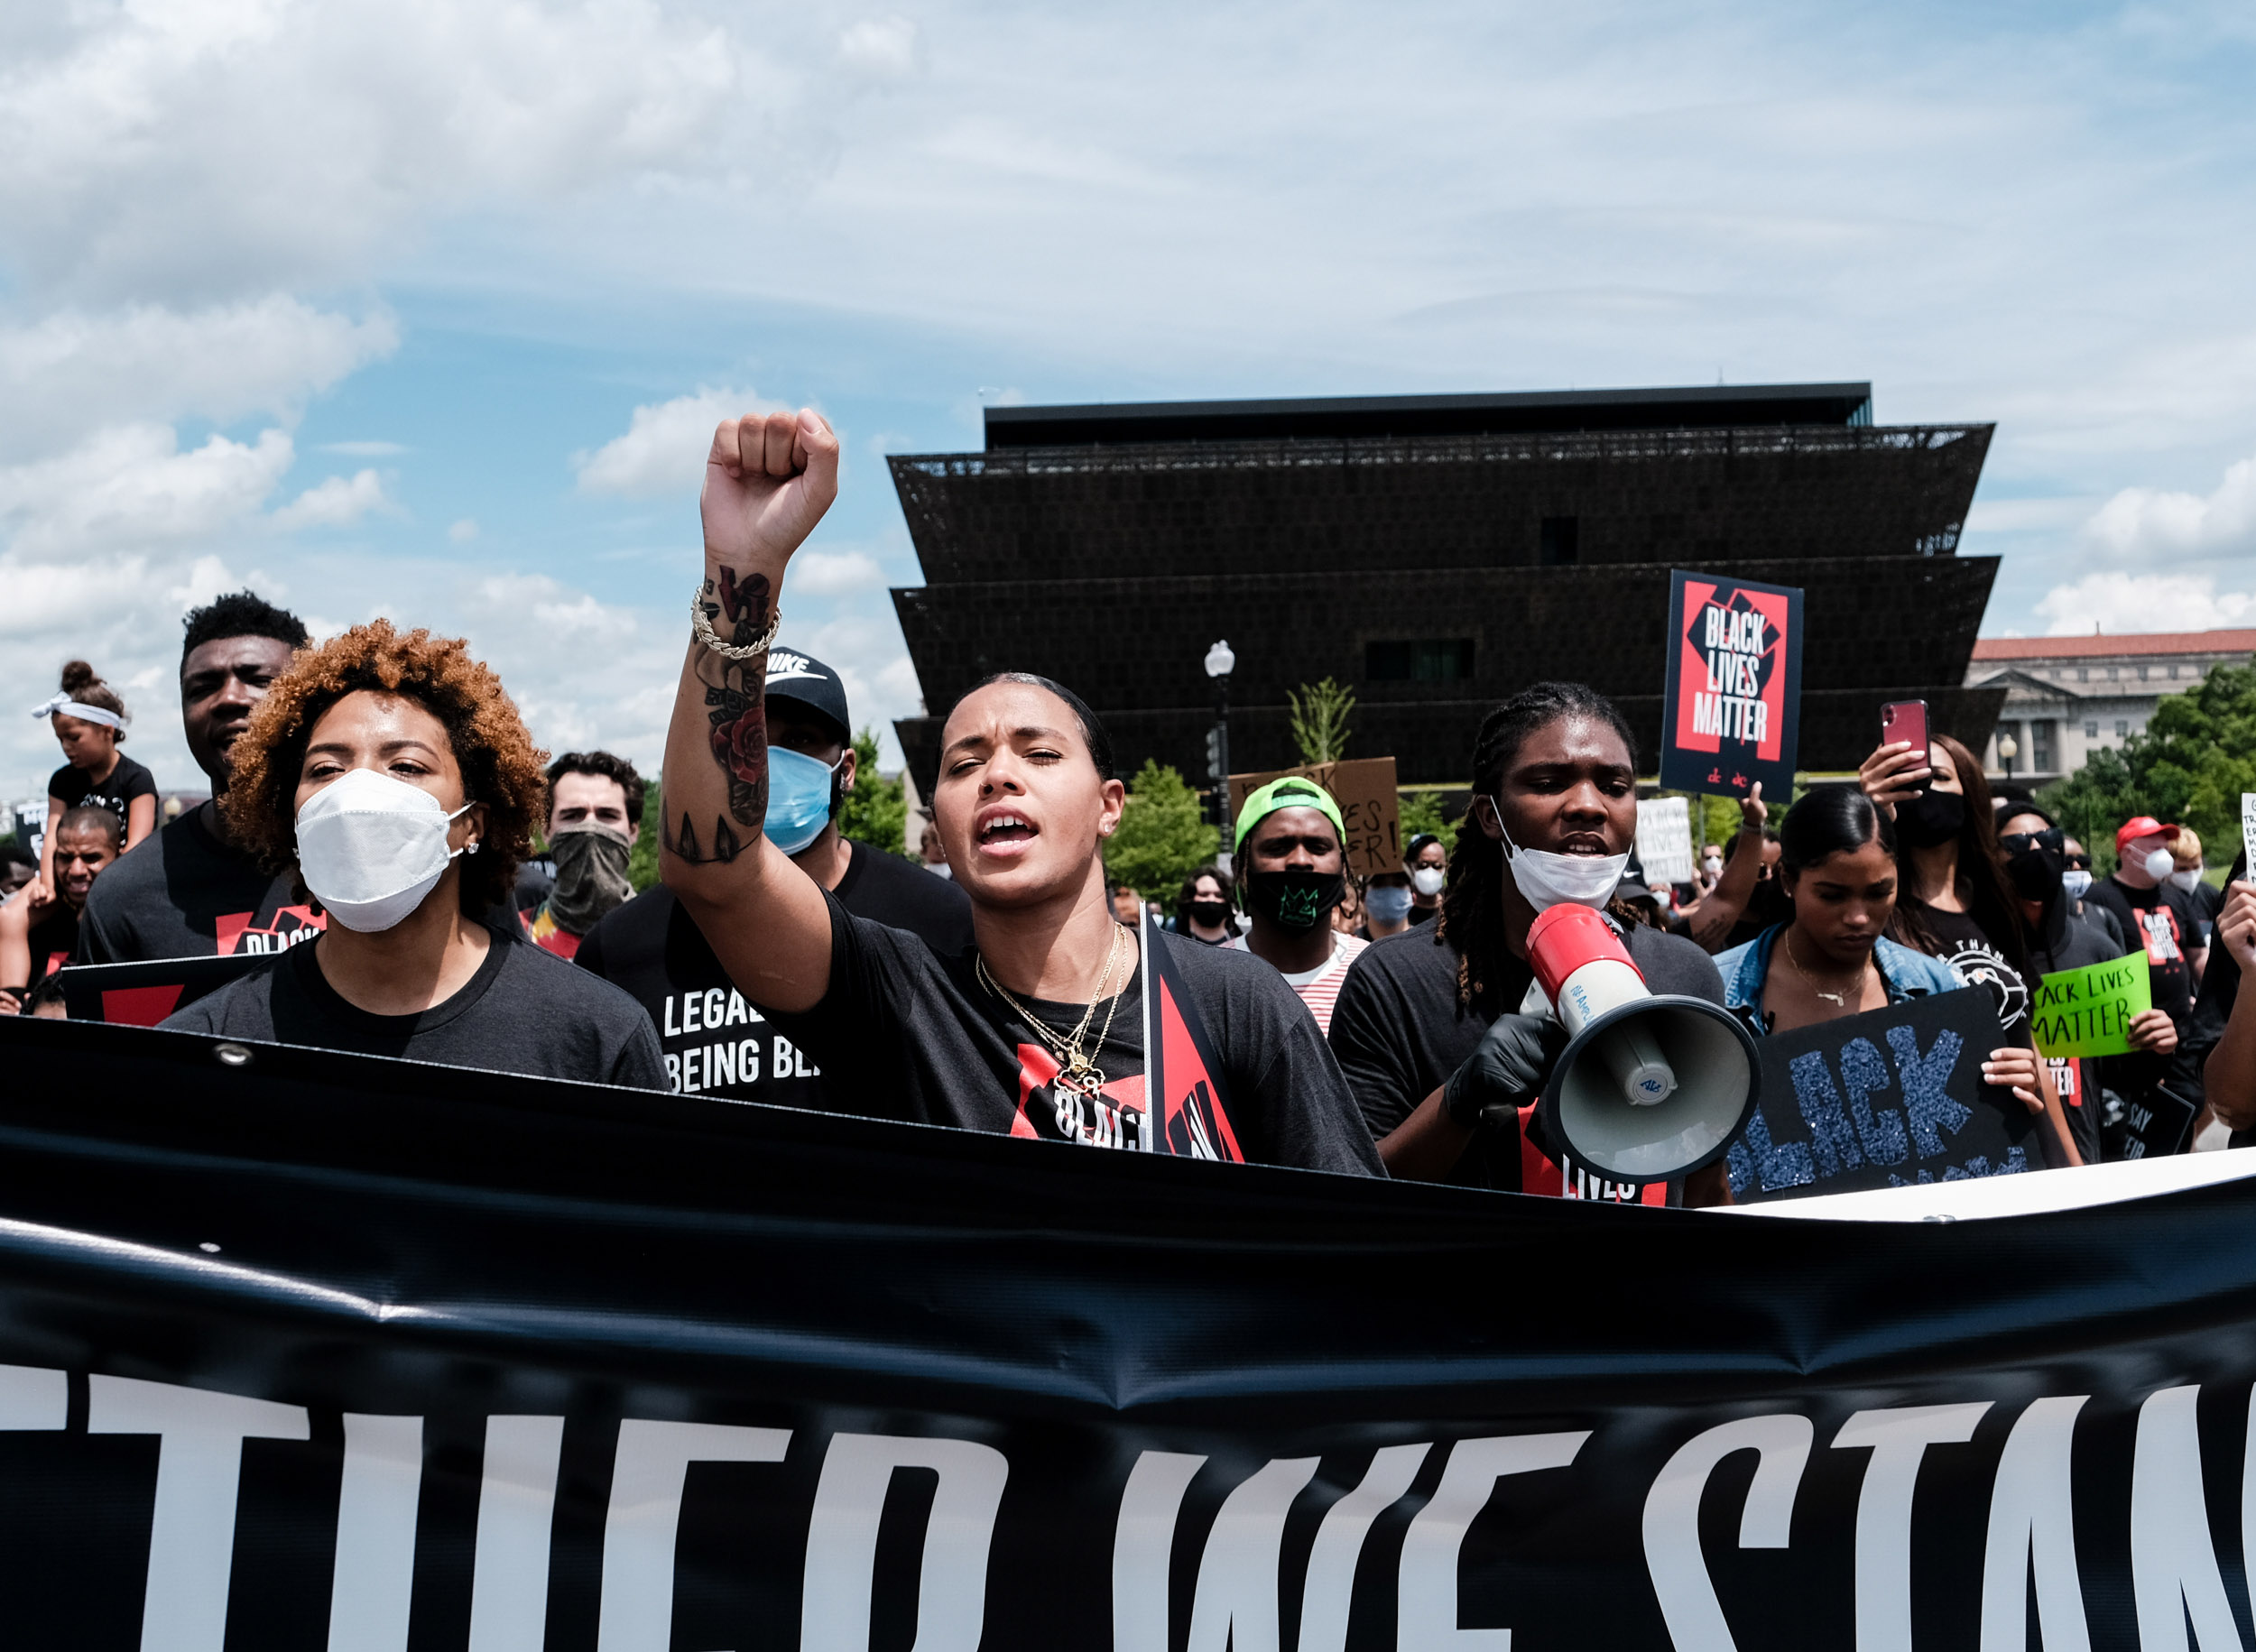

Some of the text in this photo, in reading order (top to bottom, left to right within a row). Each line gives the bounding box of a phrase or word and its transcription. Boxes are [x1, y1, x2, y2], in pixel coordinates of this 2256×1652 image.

[1706, 605, 1766, 656] BLACK
[767, 652, 810, 674] NIKE
[1706, 650, 1760, 697] LIVES
[1693, 691, 1768, 743] MATTER
[1342, 799, 1382, 833] ES
[1956, 938, 2004, 963] THAN
[2037, 965, 2135, 1009] ACK LIVES
[2031, 997, 2131, 1046] MATTER
[663, 1036, 821, 1094] BEING BL
[2128, 1103, 2153, 1133] SAY
[2123, 1133, 2146, 1160] EIR
[0, 1364, 1009, 1652] THER
[1112, 1430, 1595, 1652] WE
